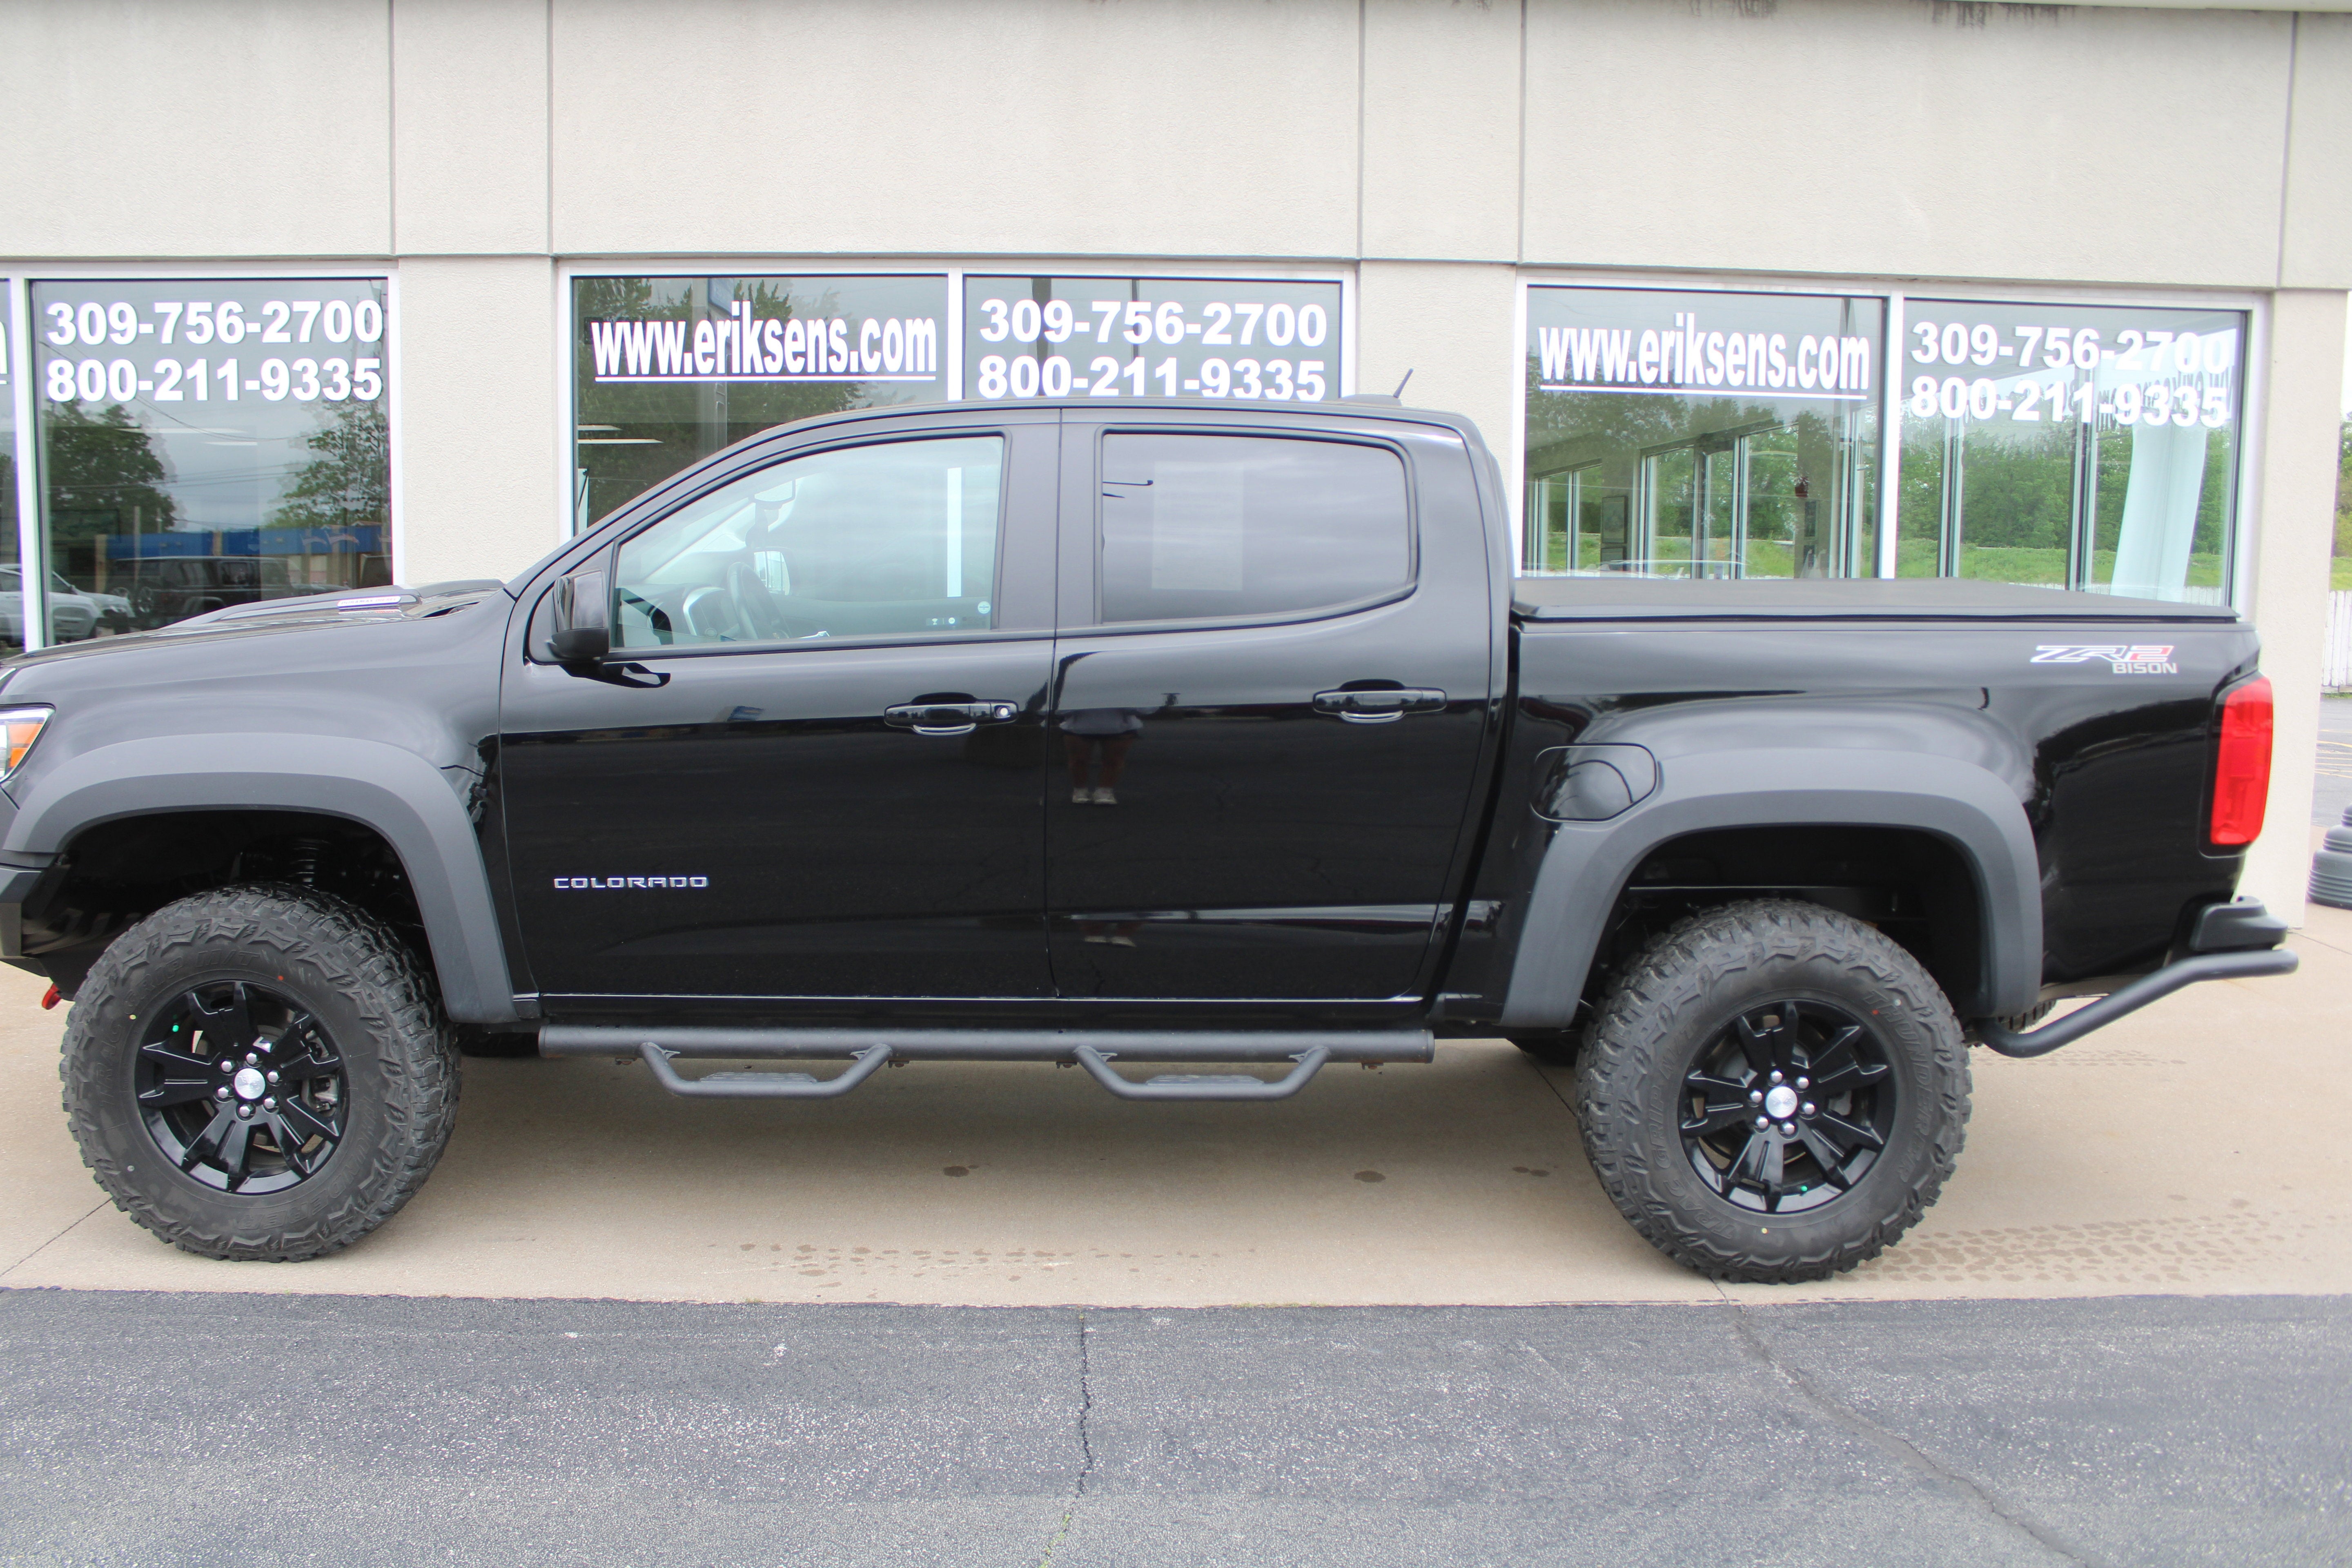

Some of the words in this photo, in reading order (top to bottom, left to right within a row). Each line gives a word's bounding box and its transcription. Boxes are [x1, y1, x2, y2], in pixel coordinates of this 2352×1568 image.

[47, 301, 383, 345] 309-756-2700
[591, 301, 936, 375] www.eriksens.com
[980, 298, 1327, 347] 309-756-2700
[1539, 313, 1870, 390] www.eriksens.com
[1911, 322, 2230, 374] 309-756-2700
[47, 359, 382, 402] 800-211-9335
[978, 355, 1326, 402] 800-211-9335
[1911, 375, 2228, 428] 800-211-9335
[2030, 646, 2174, 662] ZR2
[2113, 663, 2177, 674] BISON
[554, 877, 708, 889] COLORADO
[196, 951, 260, 967] M/T
[1648, 1086, 1670, 1169] GRIP
[1664, 1179, 1737, 1239] TRAC
